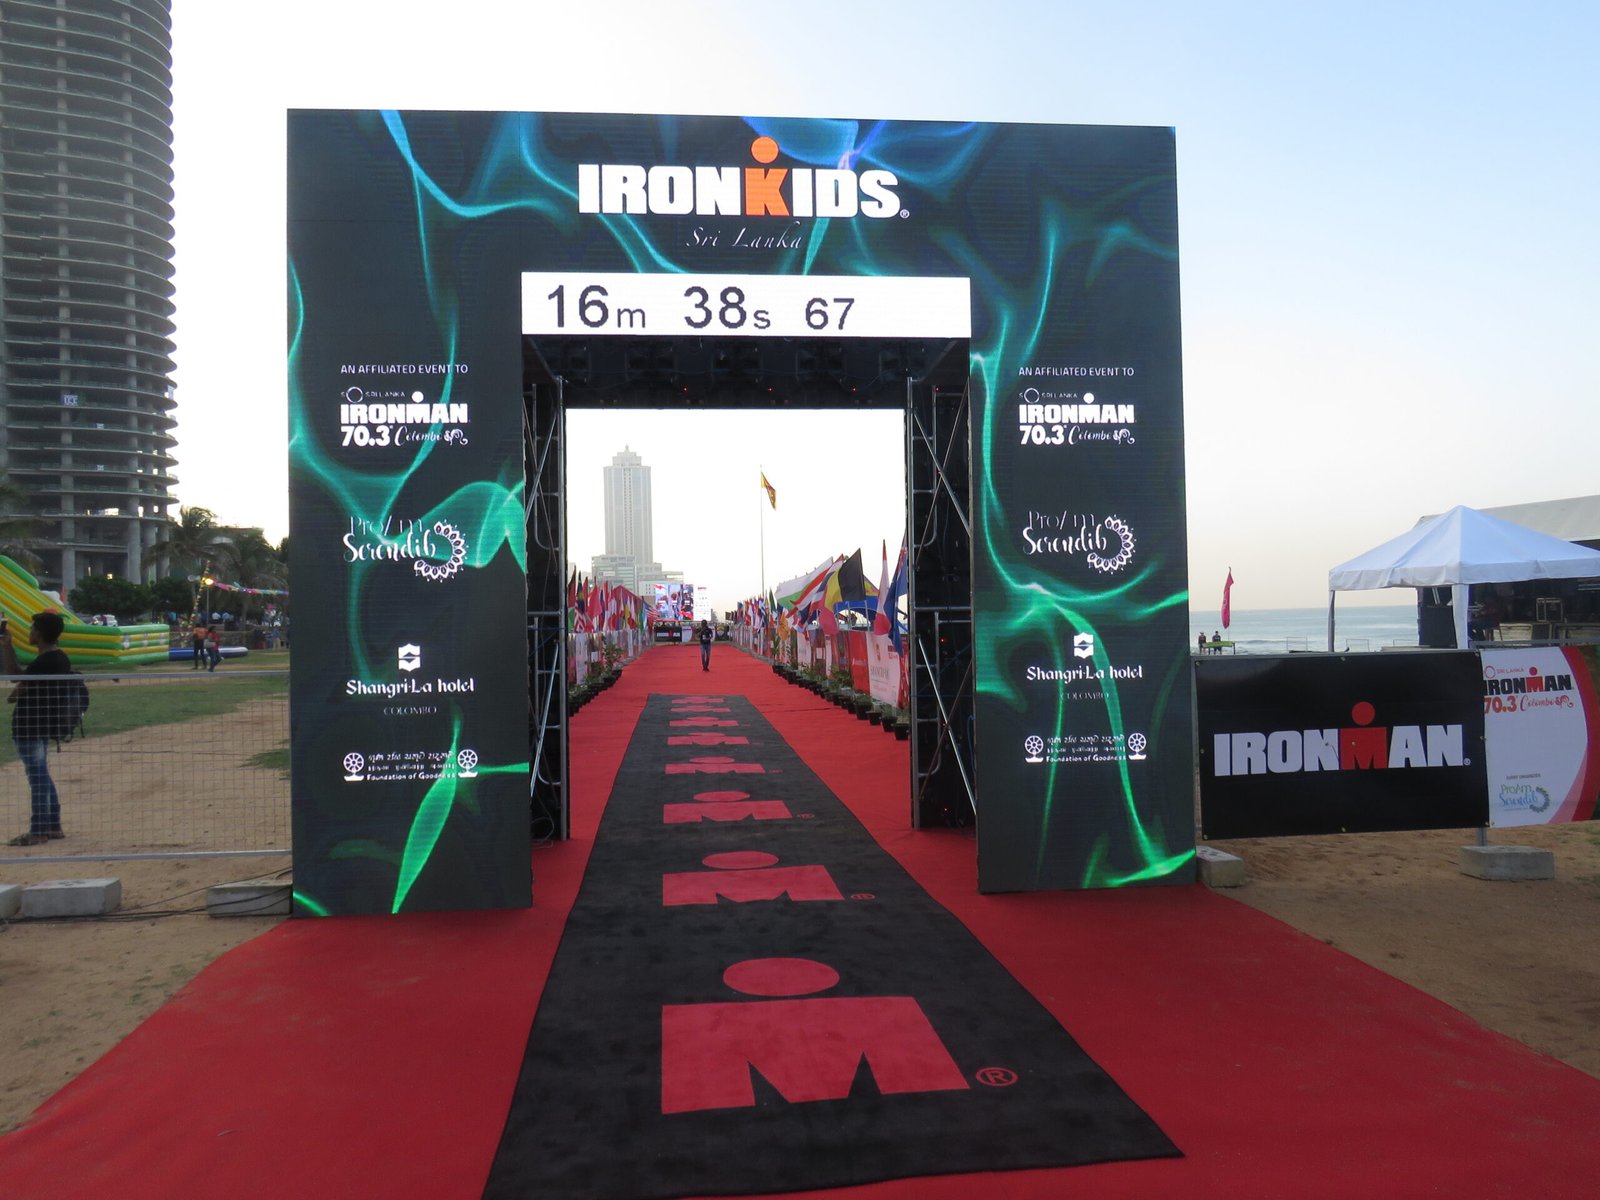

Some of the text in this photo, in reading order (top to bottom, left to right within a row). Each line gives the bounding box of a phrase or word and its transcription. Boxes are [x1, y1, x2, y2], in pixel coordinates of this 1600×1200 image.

[578, 136, 900, 218] IRONKIDS
[686, 220, 802, 249] Sri Lanka
[548, 284, 855, 331] 16m 38s 67
[340, 364, 469, 374] AN AFFILIATED EVENT TO
[1018, 367, 1135, 376] AN AFFILIATED EVENT TO
[340, 391, 469, 424] IRONMAN
[1019, 392, 1135, 424] IRONMAN
[340, 425, 391, 447] 70.3
[1019, 424, 1065, 445] 70.3
[342, 529, 436, 563] Serendib
[1022, 523, 1107, 555] Serendib
[1109, 664, 1143, 679] hotel
[437, 677, 475, 693] hotel
[1483, 695, 1518, 714] 70.3
[1214, 701, 1464, 777] IRONMAN
[1046, 755, 1081, 763] Foundation
[366, 773, 407, 781] Foundation
[661, 957, 971, 1115] M
